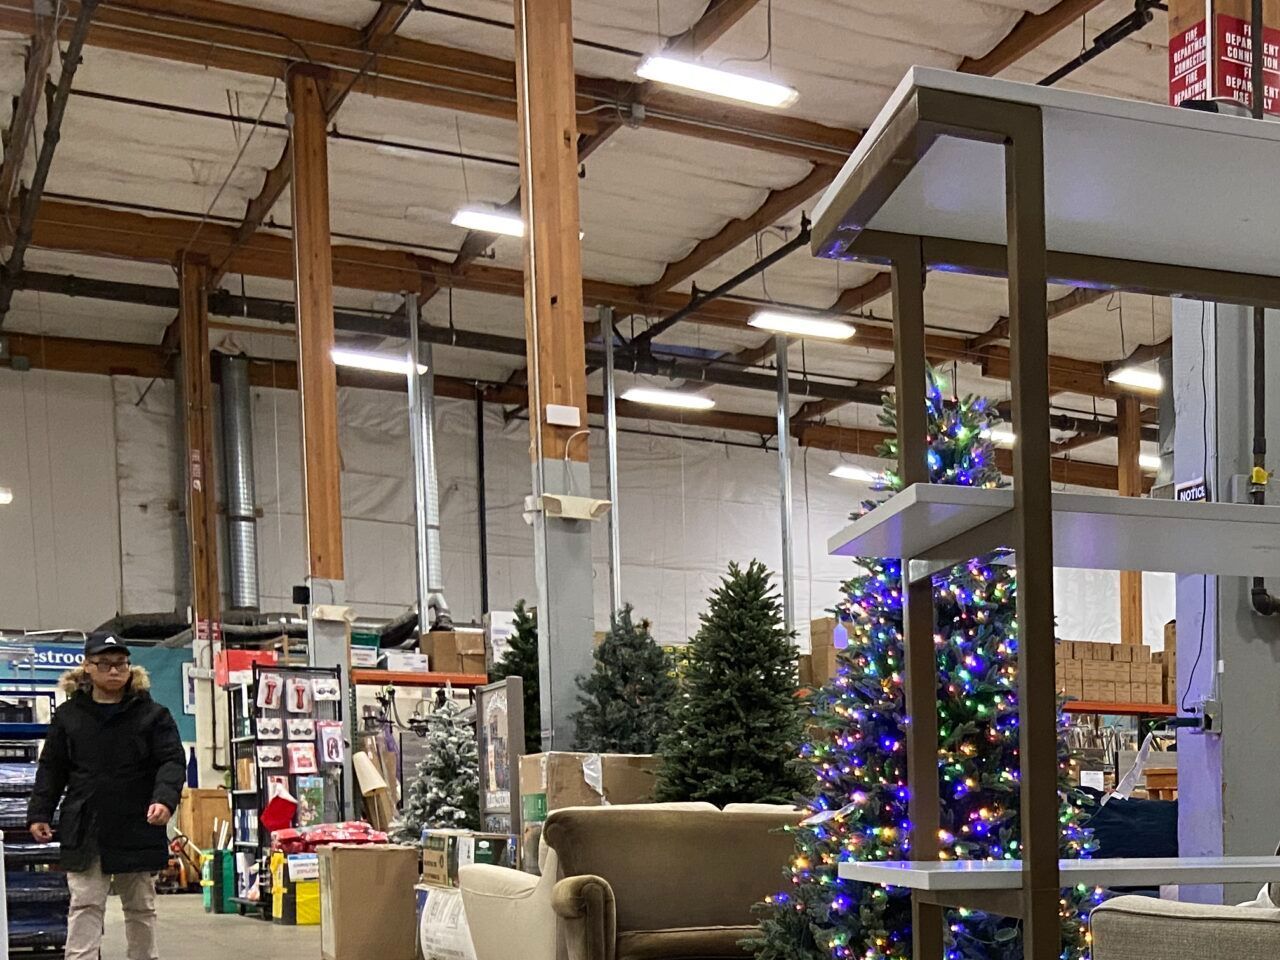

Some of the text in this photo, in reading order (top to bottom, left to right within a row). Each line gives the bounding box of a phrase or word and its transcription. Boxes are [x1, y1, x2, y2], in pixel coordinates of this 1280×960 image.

[1174, 36, 1206, 63] DEPARTMEN
[1175, 50, 1206, 76] CONNECTIO
[1174, 79, 1206, 106] DEPARTMEN
[1180, 486, 1205, 501] NOTICE
